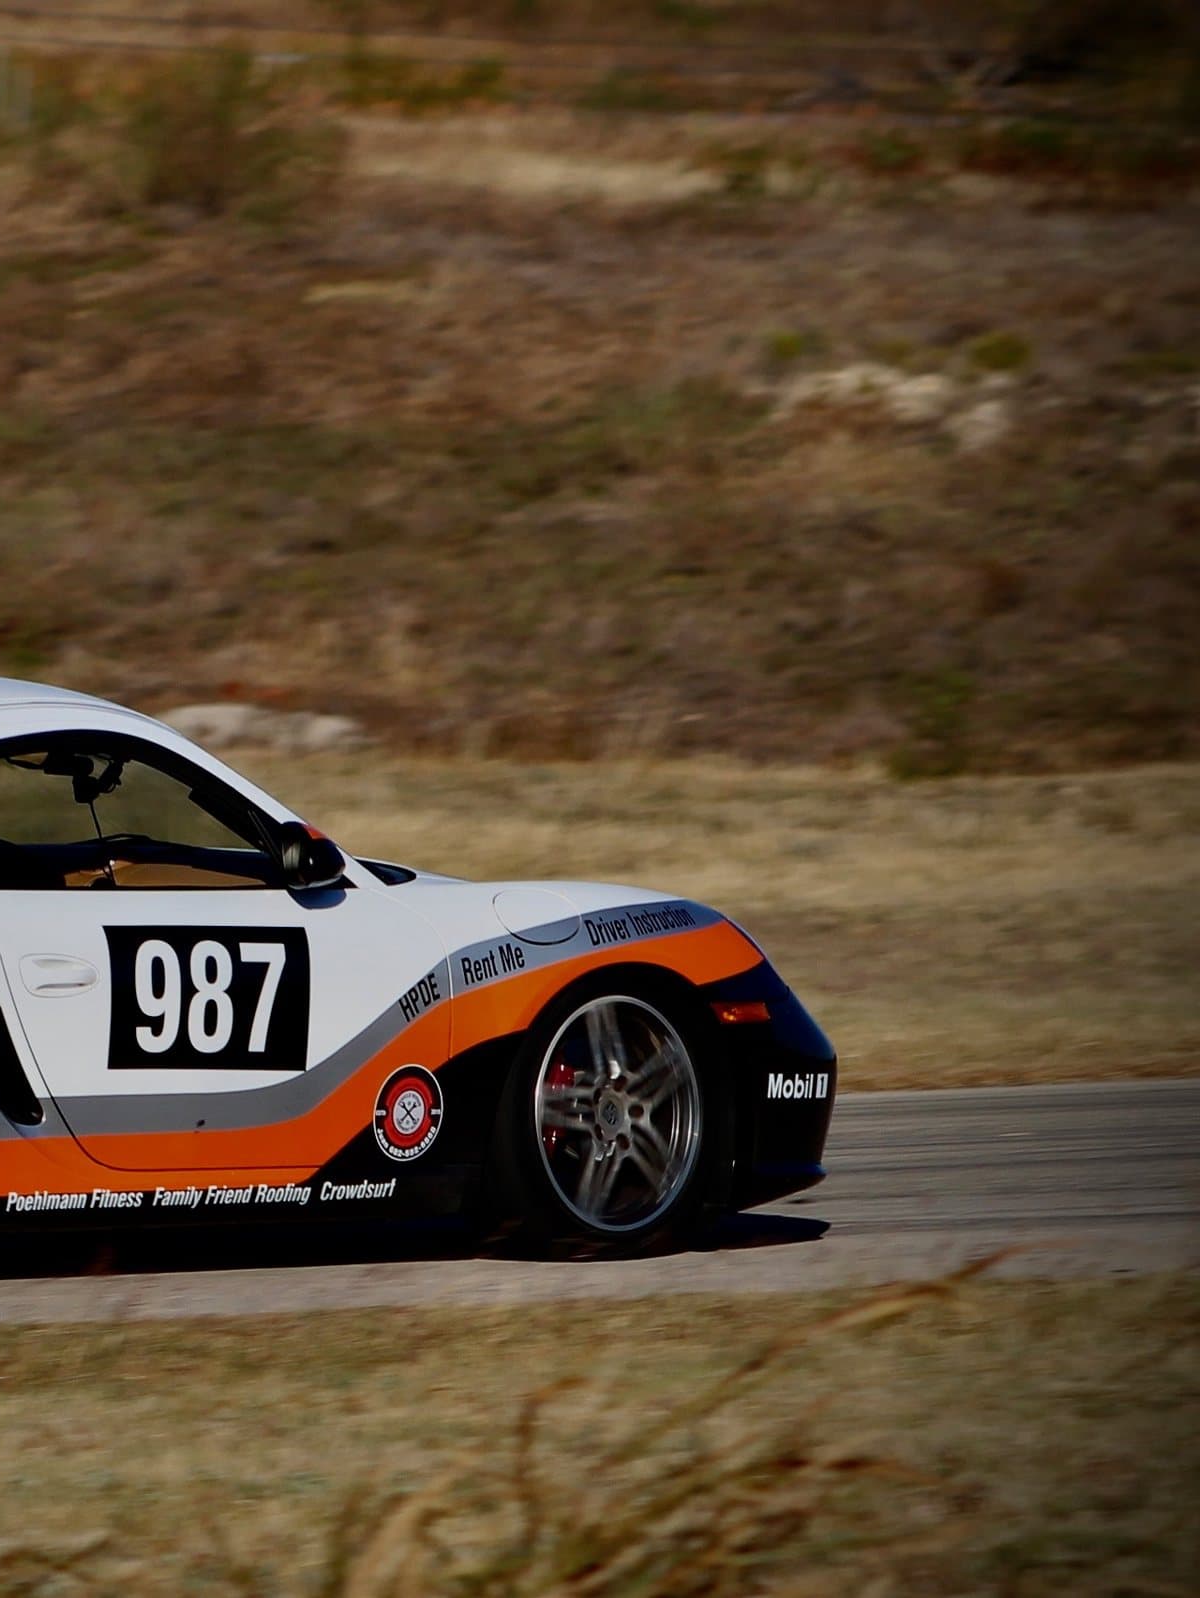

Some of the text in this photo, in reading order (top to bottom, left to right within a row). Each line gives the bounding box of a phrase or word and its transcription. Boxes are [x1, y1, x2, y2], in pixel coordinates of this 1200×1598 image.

[583, 905, 697, 947] Driver Instruction
[460, 943, 526, 986] Rent Me
[135, 939, 287, 1054] 987
[398, 972, 442, 1023] HPDE
[767, 1073, 829, 1099] Mobil 1
[5, 1188, 144, 1212] Poehlmann Fitness
[152, 1183, 311, 1209] Family Friend Roofing
[319, 1178, 398, 1201] Crowdsurf
